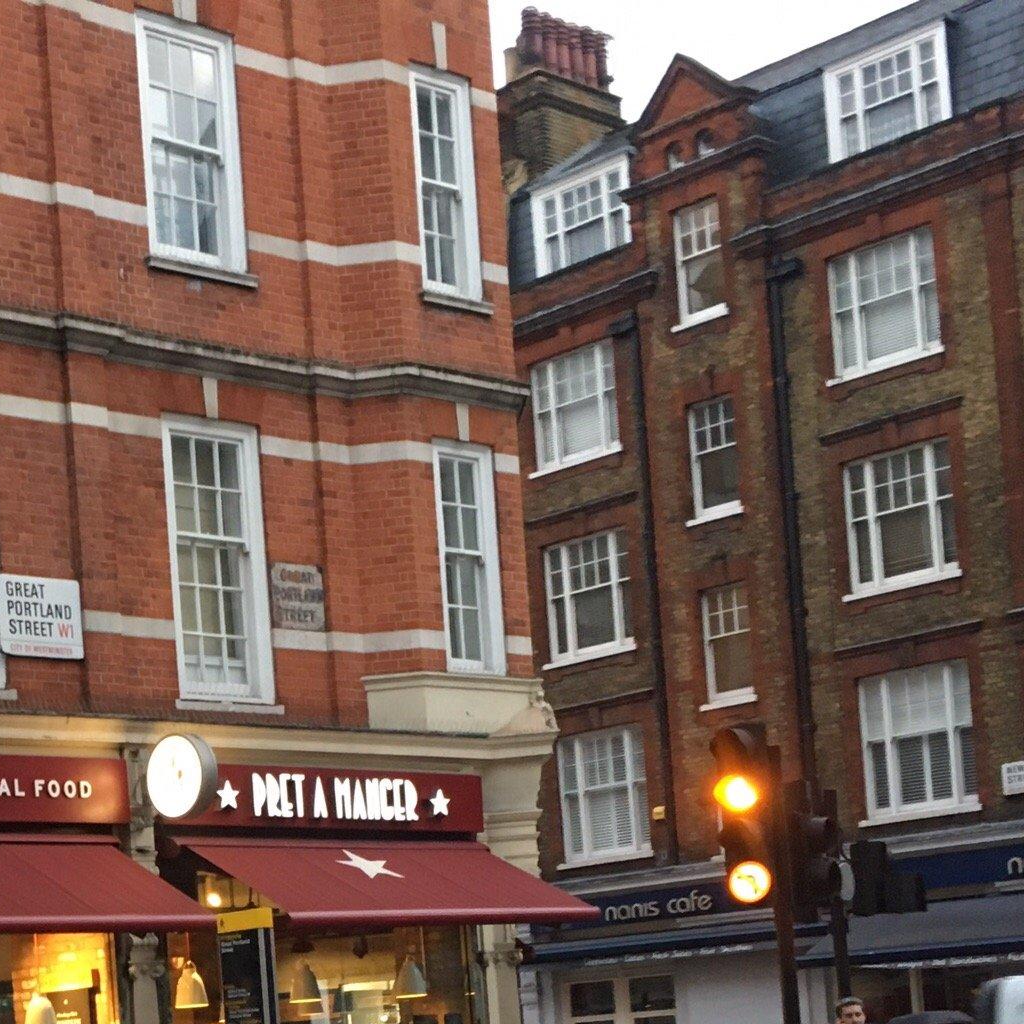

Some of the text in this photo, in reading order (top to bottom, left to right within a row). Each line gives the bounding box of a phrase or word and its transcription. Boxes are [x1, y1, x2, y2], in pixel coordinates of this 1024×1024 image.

[5, 581, 45, 599] GREAT
[7, 600, 72, 620] PORTLAND
[9, 619, 74, 639] STREET W1
[34, 779, 93, 799] FOOD
[251, 772, 420, 822] PRET A MANGER
[604, 900, 661, 922] nanis
